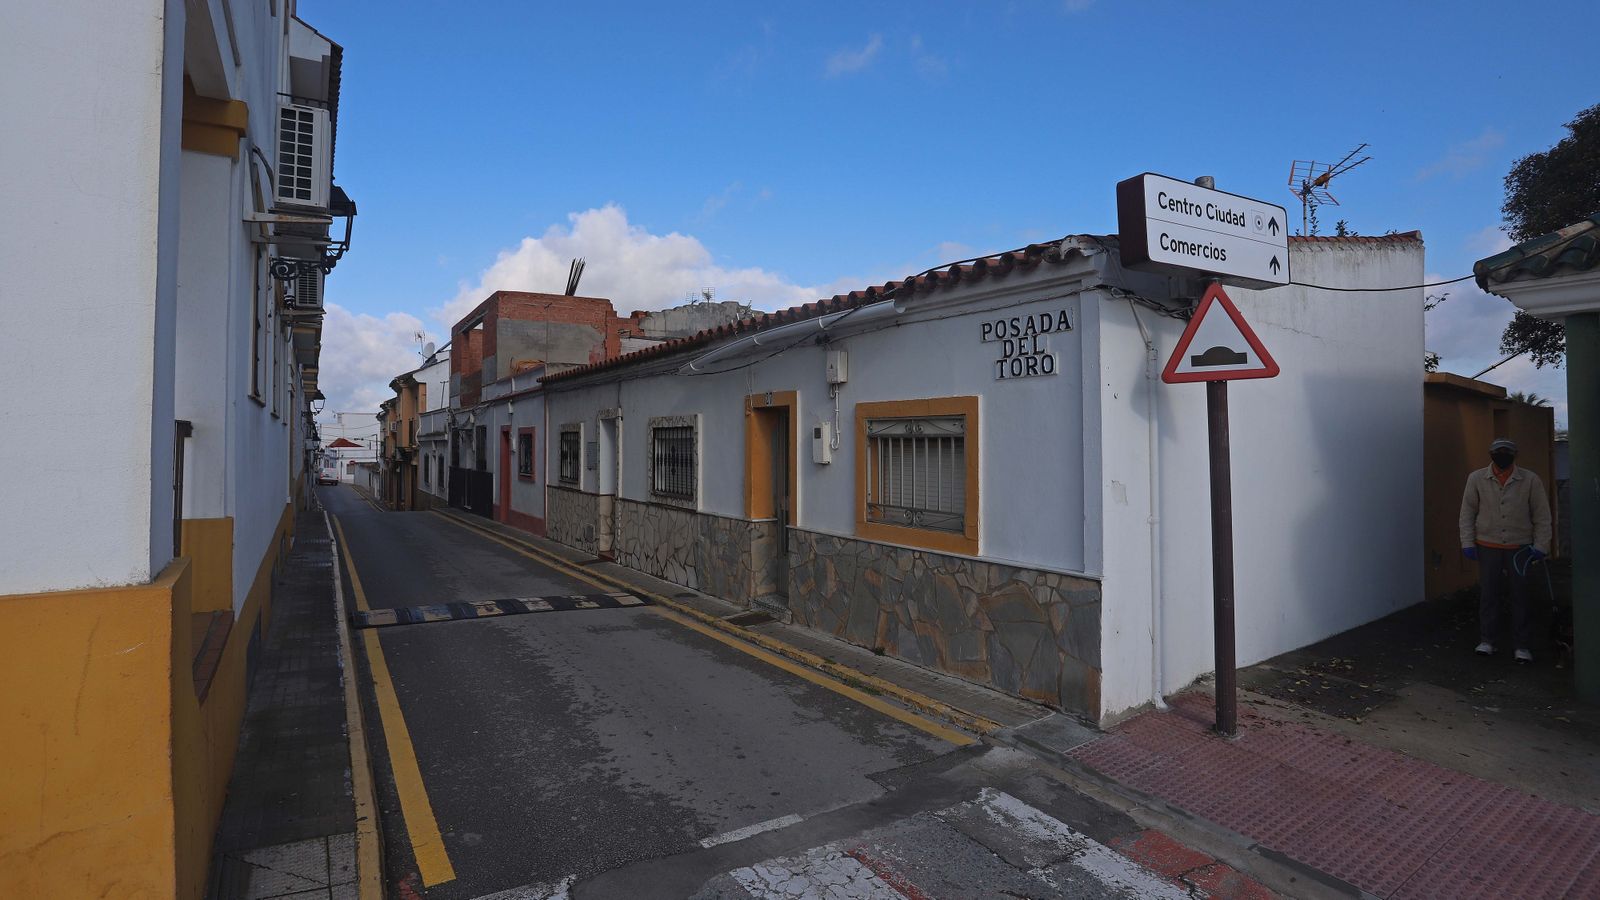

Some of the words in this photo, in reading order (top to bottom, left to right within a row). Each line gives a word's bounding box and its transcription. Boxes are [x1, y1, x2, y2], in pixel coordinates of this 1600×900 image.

[1158, 191, 1202, 218] Centro
[1206, 203, 1246, 228] Ciudad
[1160, 233, 1226, 262] Comercios
[981, 309, 1072, 341] POSADA
[1002, 335, 1045, 358] DEL
[996, 354, 1054, 378] TORO
